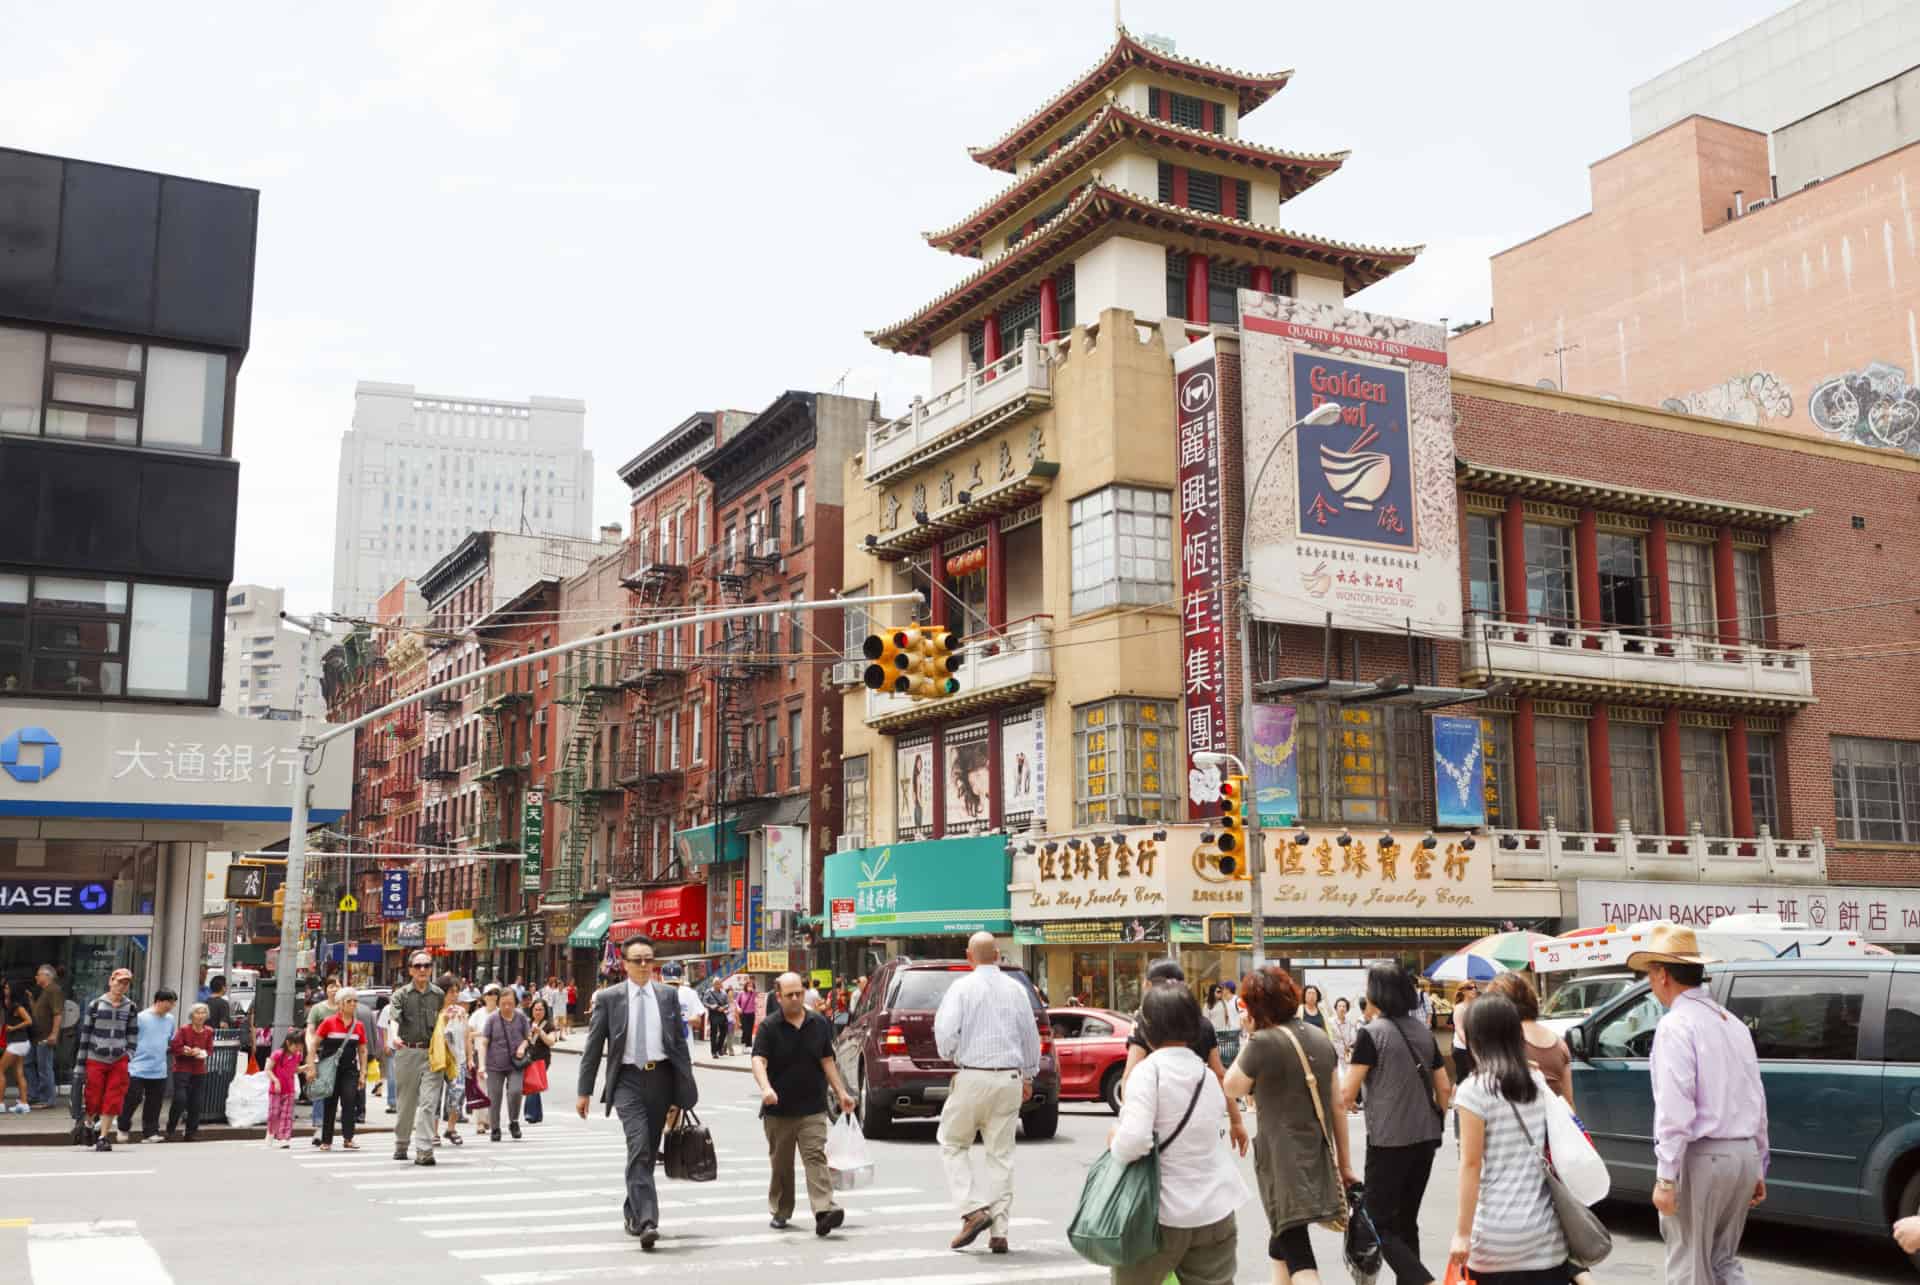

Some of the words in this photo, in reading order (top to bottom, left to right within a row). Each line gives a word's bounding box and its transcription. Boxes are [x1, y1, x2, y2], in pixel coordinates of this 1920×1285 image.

[1287, 324, 1330, 342] QUALITY
[1331, 333, 1341, 343] IS
[1343, 335, 1379, 351] ALWAYS
[1310, 366, 1388, 404] Golden
[1312, 393, 1367, 428] wl
[1335, 591, 1373, 602] WONTON
[1375, 594, 1398, 606] FOOD
[113, 738, 299, 785] 大通銀行
[1084, 887, 1129, 907] Jewelry
[1363, 887, 1427, 909] Jewelry
[1601, 902, 1661, 923] TAIPAN
[1838, 901, 1888, 931] 餅店
[1548, 952, 1560, 962] 23
